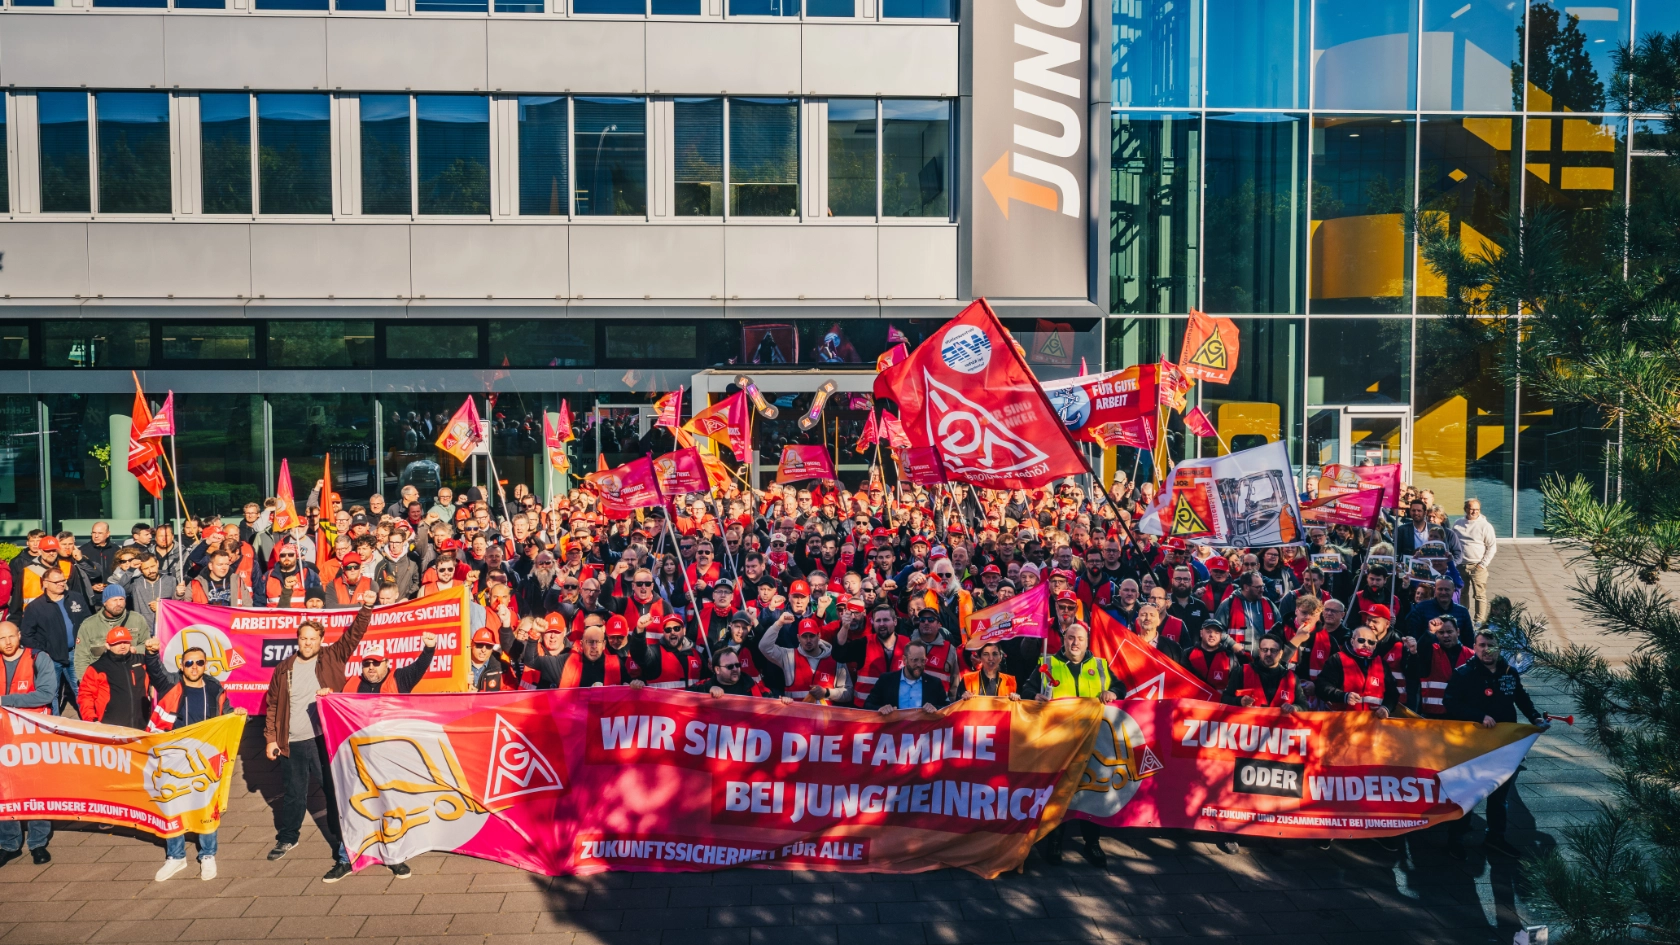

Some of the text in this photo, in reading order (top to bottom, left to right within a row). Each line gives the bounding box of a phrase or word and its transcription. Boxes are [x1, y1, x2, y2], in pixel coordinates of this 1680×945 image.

[1186, 366, 1227, 379] STILL
[1091, 378, 1137, 396] FÜR GUTE
[1096, 394, 1128, 410] ARBEIT
[330, 614, 354, 628] UND
[368, 609, 415, 627] ANDORTE
[415, 603, 460, 620] SICHERN
[396, 654, 452, 673] KOEN!
[600, 715, 996, 766] WIR SIND DIE FAMILIE
[1181, 719, 1312, 756] ZUKUNFT
[0, 741, 131, 774] ODUKTION
[1240, 765, 1298, 790] ODER
[725, 780, 785, 814] BEI
[23, 799, 45, 811] FÜR
[48, 801, 86, 812] UNSERE
[88, 802, 129, 816] ZUKUNFT
[130, 809, 147, 821] UND
[1202, 806, 1217, 818] FÜR
[1219, 809, 1255, 821] ZUKUNFT
[1257, 813, 1275, 823] UND
[1277, 815, 1347, 826] ZUSAMMENHALT
[1349, 818, 1363, 828] BEI
[782, 840, 816, 858] FÜR
[819, 842, 863, 860] ALLE
